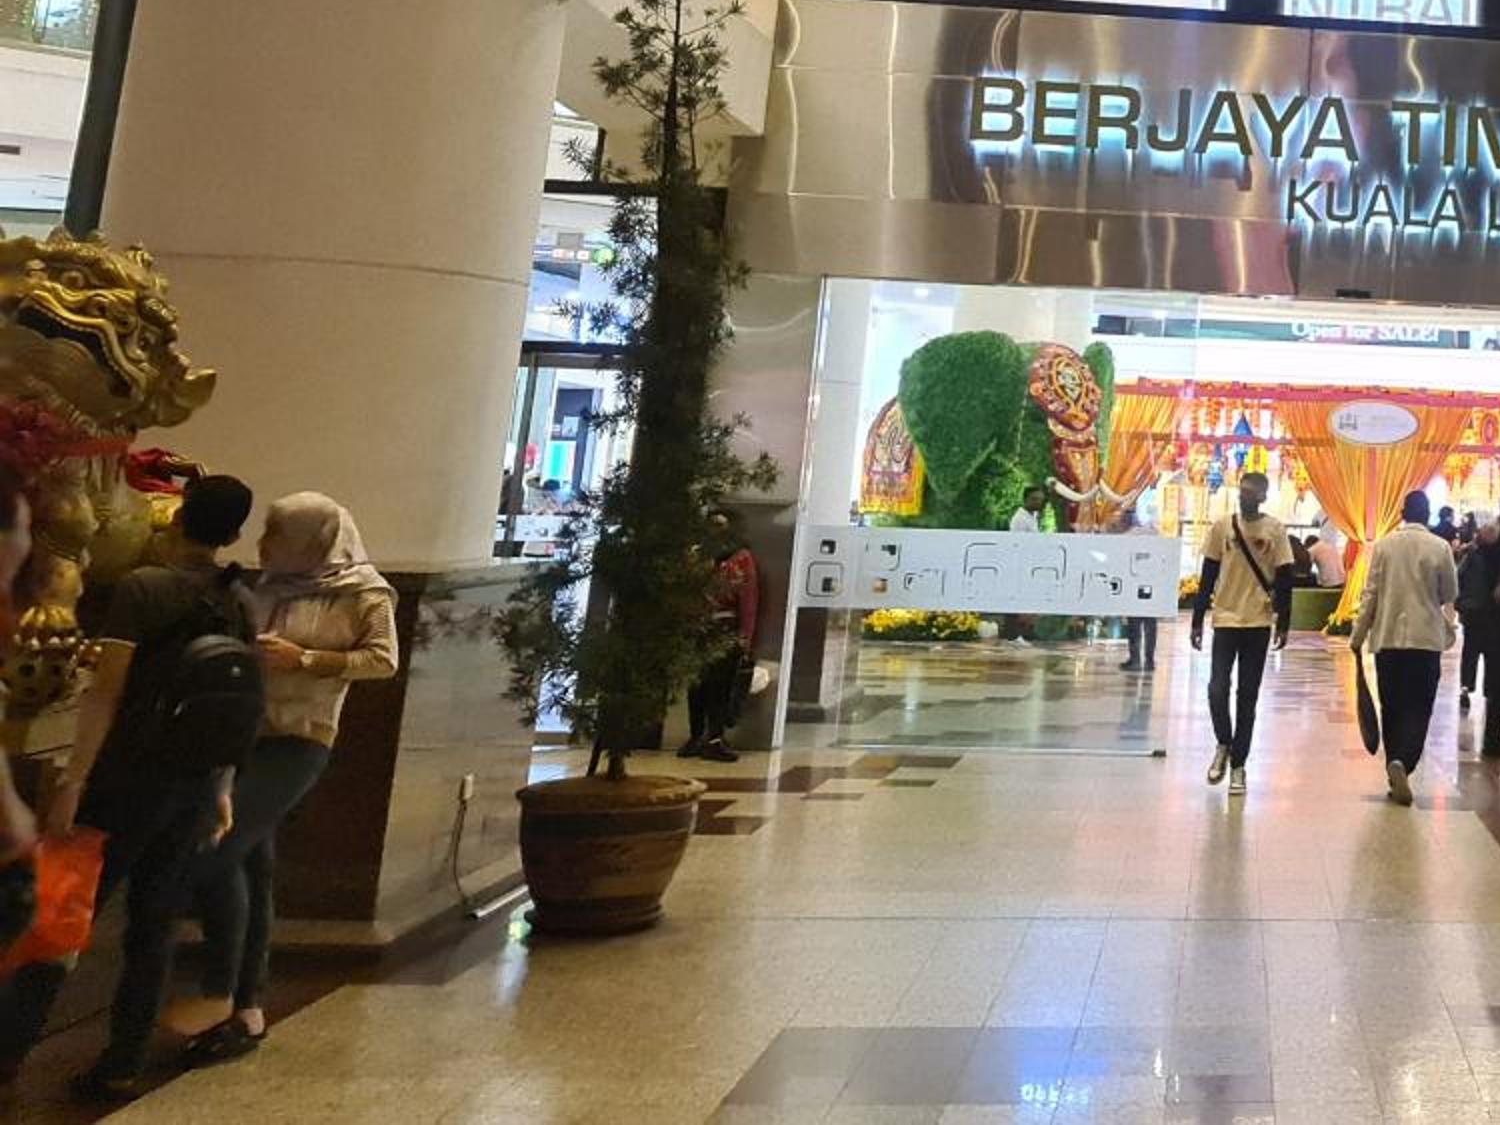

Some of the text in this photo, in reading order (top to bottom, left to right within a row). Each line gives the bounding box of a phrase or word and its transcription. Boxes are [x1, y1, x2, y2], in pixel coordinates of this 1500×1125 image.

[969, 76, 1358, 162] BERJAYA
[1287, 178, 1469, 227] KUALA
[1291, 322, 1343, 342] Open
